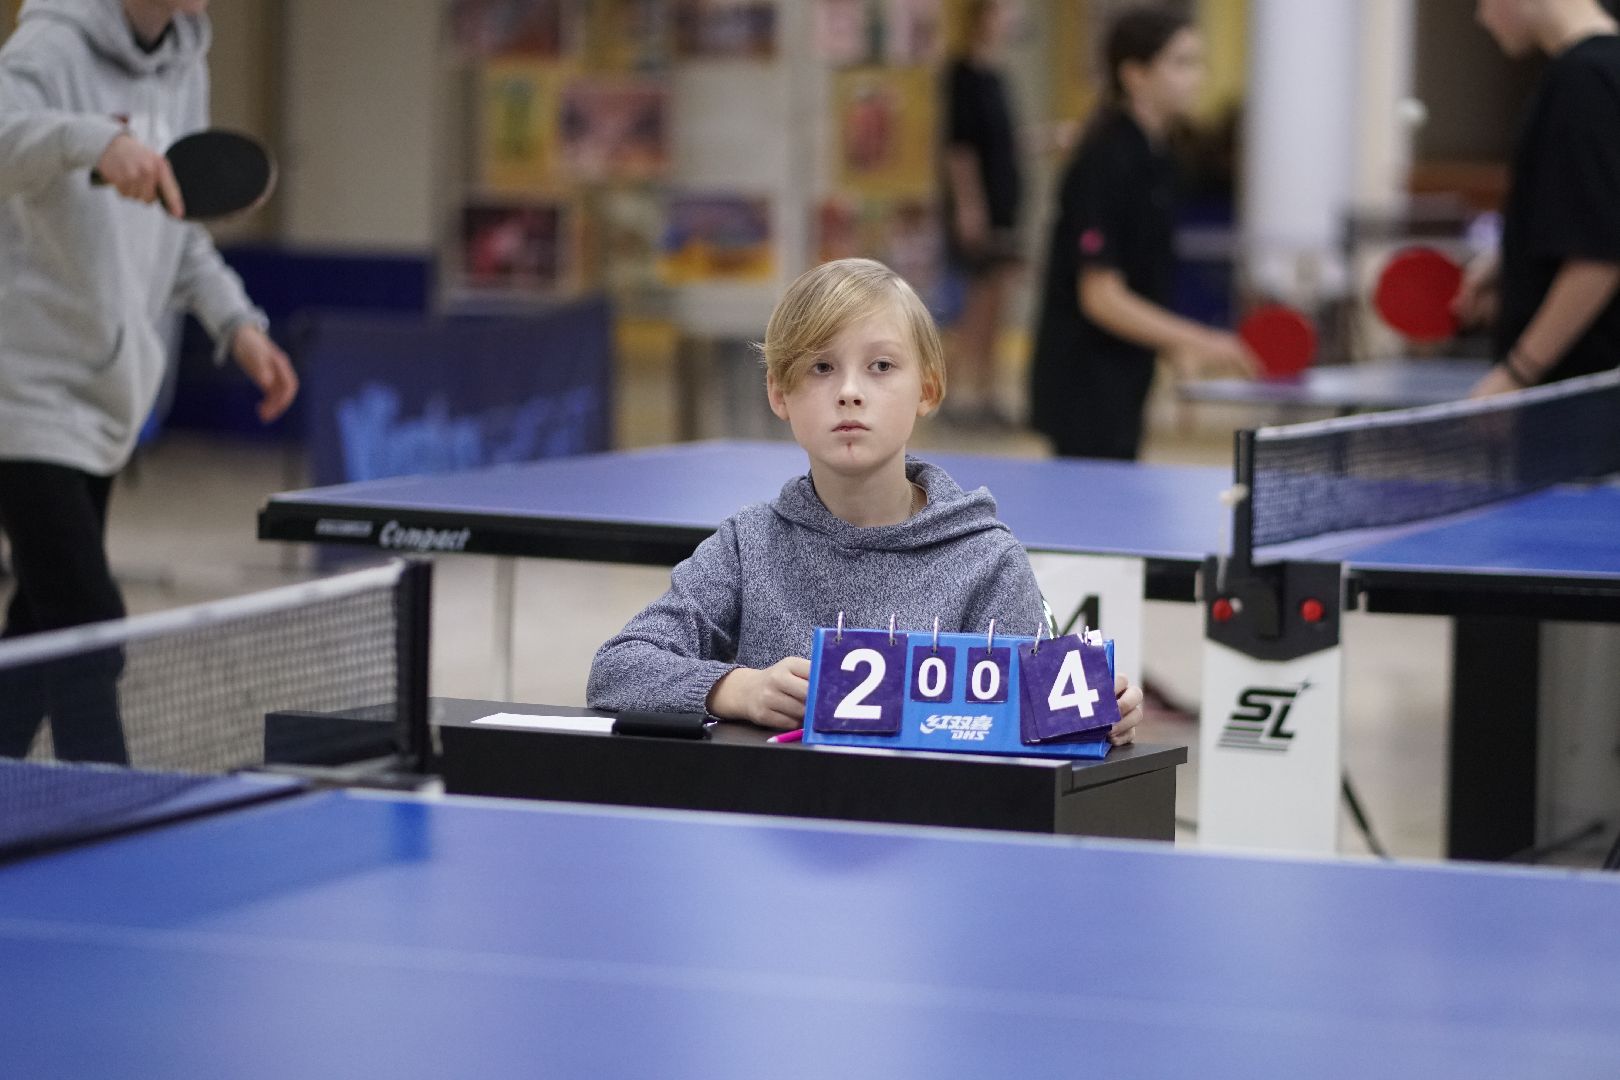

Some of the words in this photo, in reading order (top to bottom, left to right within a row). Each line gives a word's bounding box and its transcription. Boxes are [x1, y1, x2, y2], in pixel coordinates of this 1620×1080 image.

[834, 648, 886, 720] 2
[918, 656, 947, 698] 0
[971, 660, 1001, 700] 0
[1047, 649, 1100, 719] 4
[951, 730, 990, 741] DHS
